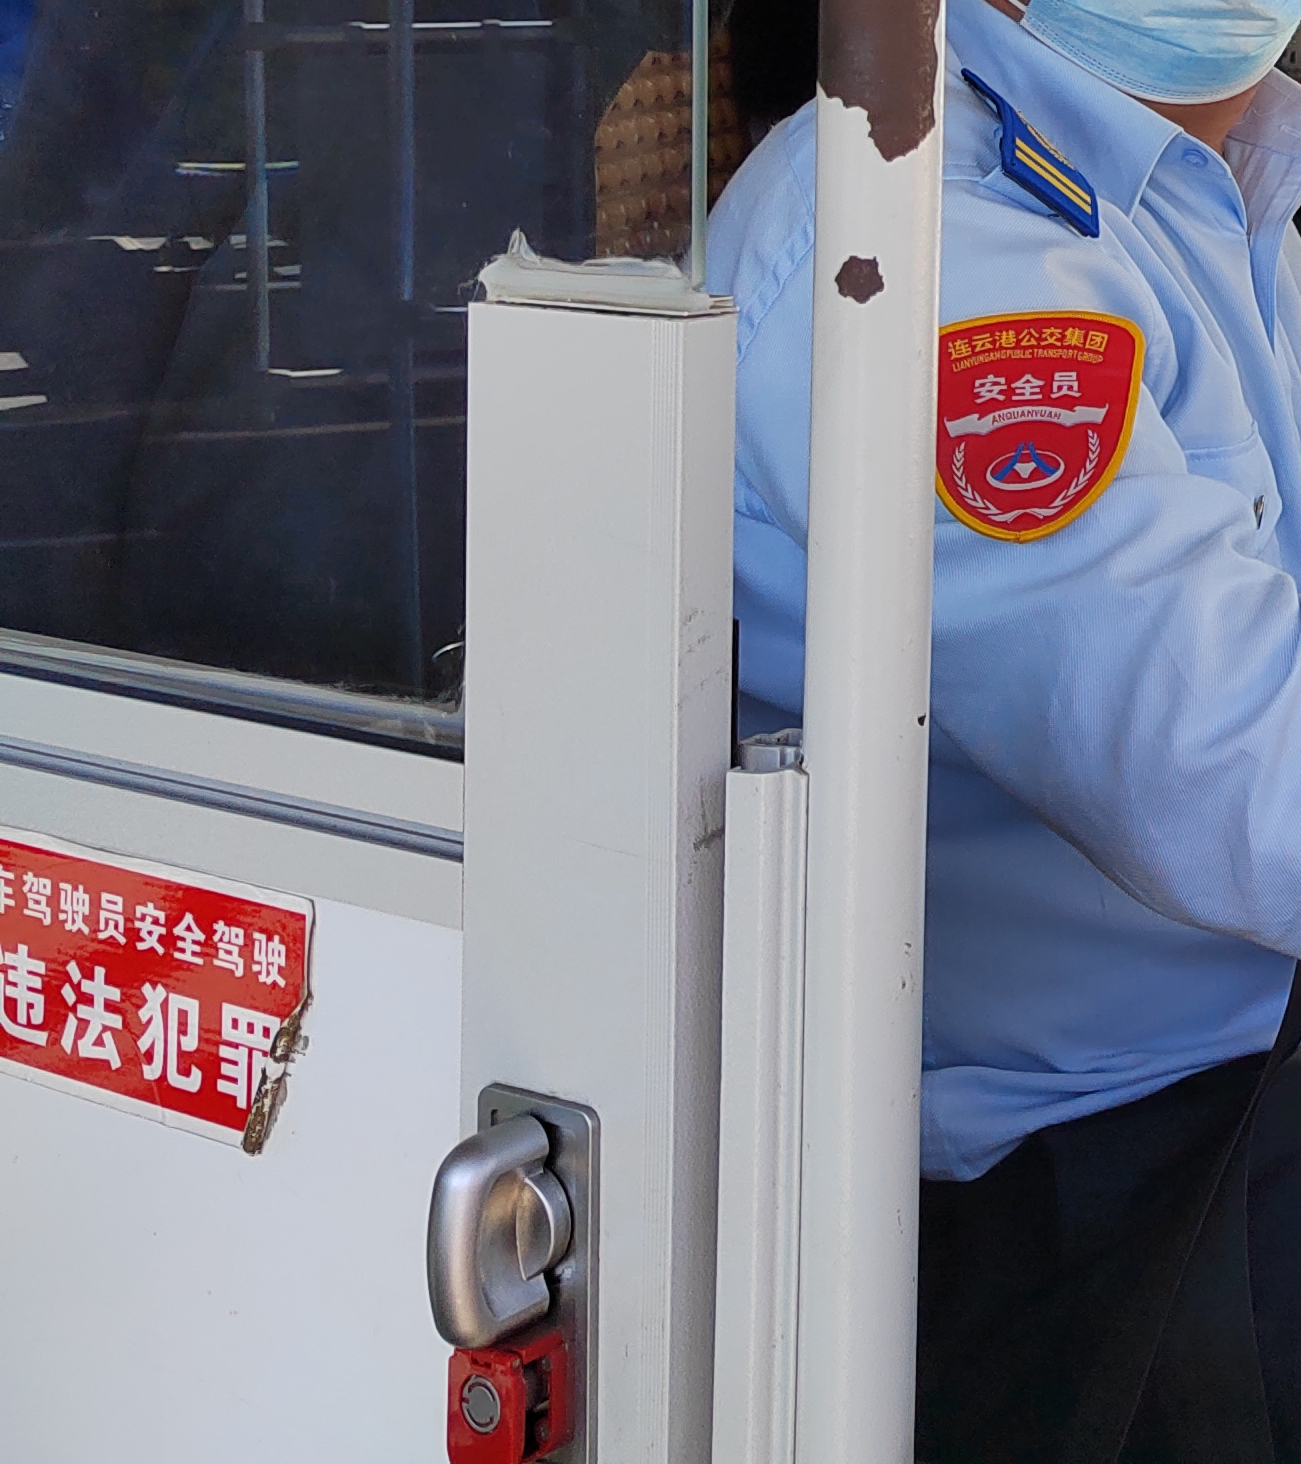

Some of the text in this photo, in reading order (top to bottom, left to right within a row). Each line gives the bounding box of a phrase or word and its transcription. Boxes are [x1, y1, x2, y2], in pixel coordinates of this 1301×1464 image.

[948, 327, 1108, 360] 连云港公交集团
[973, 371, 1082, 404] 安全员
[991, 408, 1062, 426] ANQUANYUAN
[0, 943, 281, 1110] 违法犯罪
